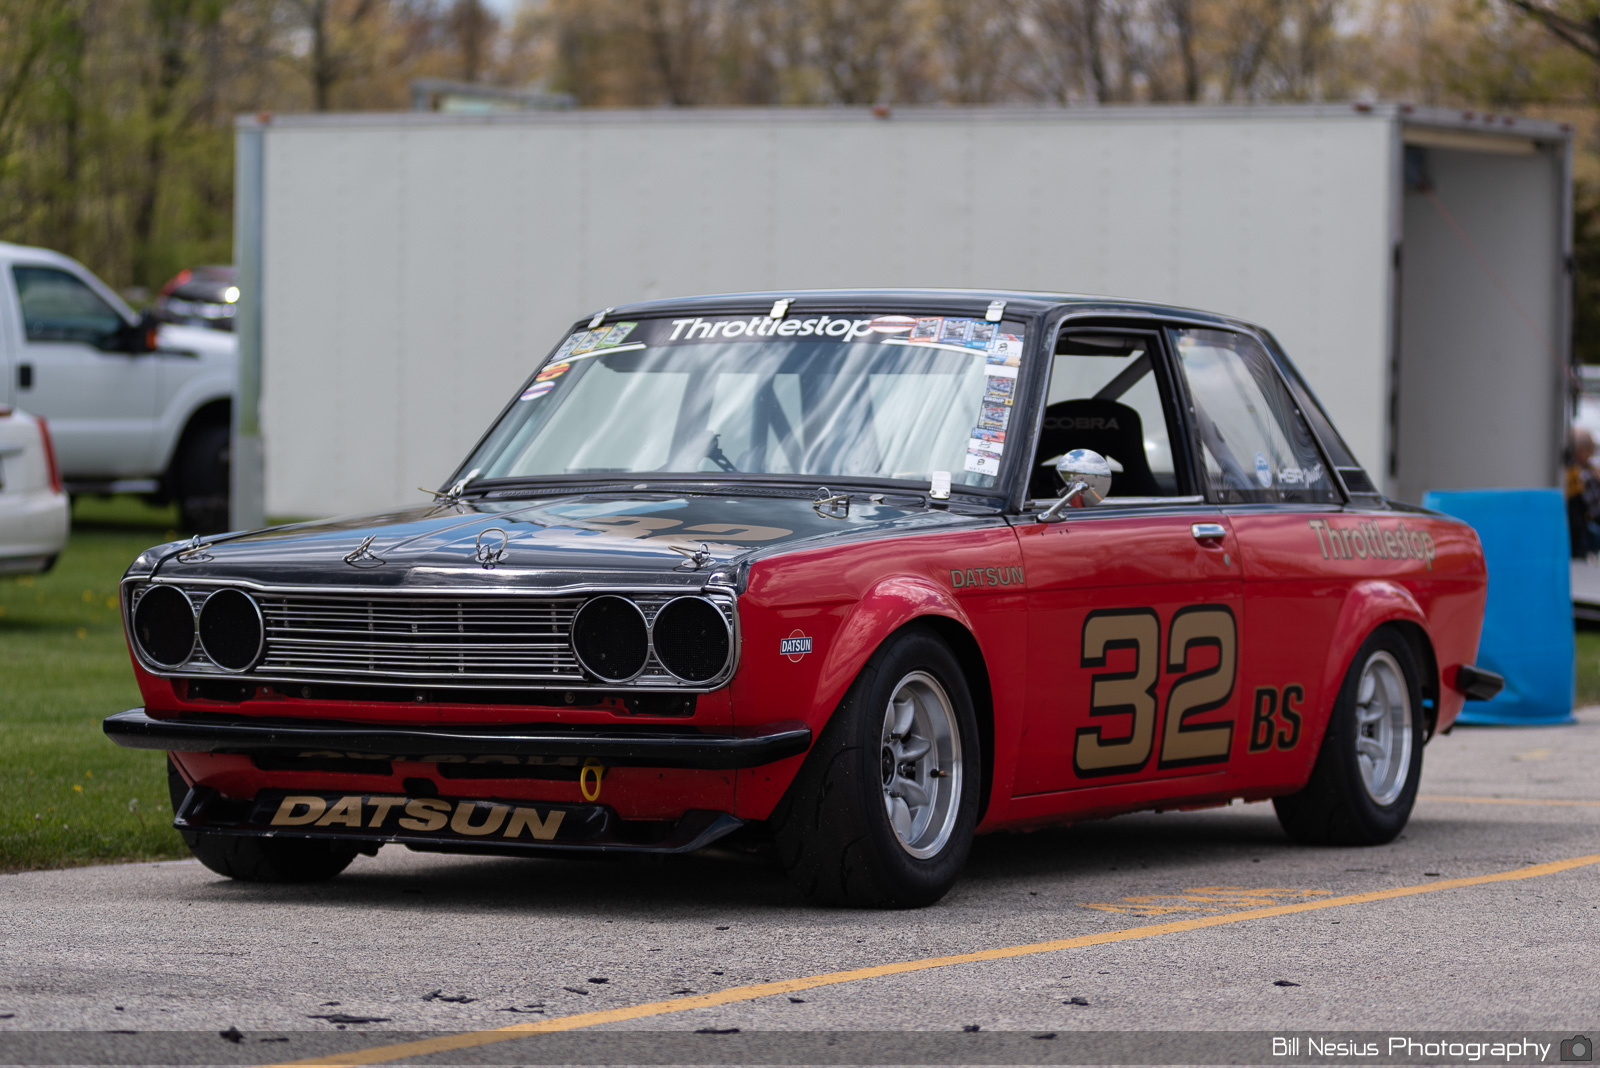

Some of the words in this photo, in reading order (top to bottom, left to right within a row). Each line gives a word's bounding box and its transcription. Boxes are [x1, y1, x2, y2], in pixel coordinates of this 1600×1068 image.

[668, 315, 876, 343] Throttlestop
[1043, 416, 1119, 430] COBRA
[532, 516, 794, 550] 32
[1308, 517, 1436, 572] Throttlestop
[950, 565, 1024, 588] DATSUN
[781, 639, 811, 653] DATSUN
[1072, 603, 1239, 780] 32
[1247, 683, 1305, 755] BS
[270, 795, 567, 841] DATSUN
